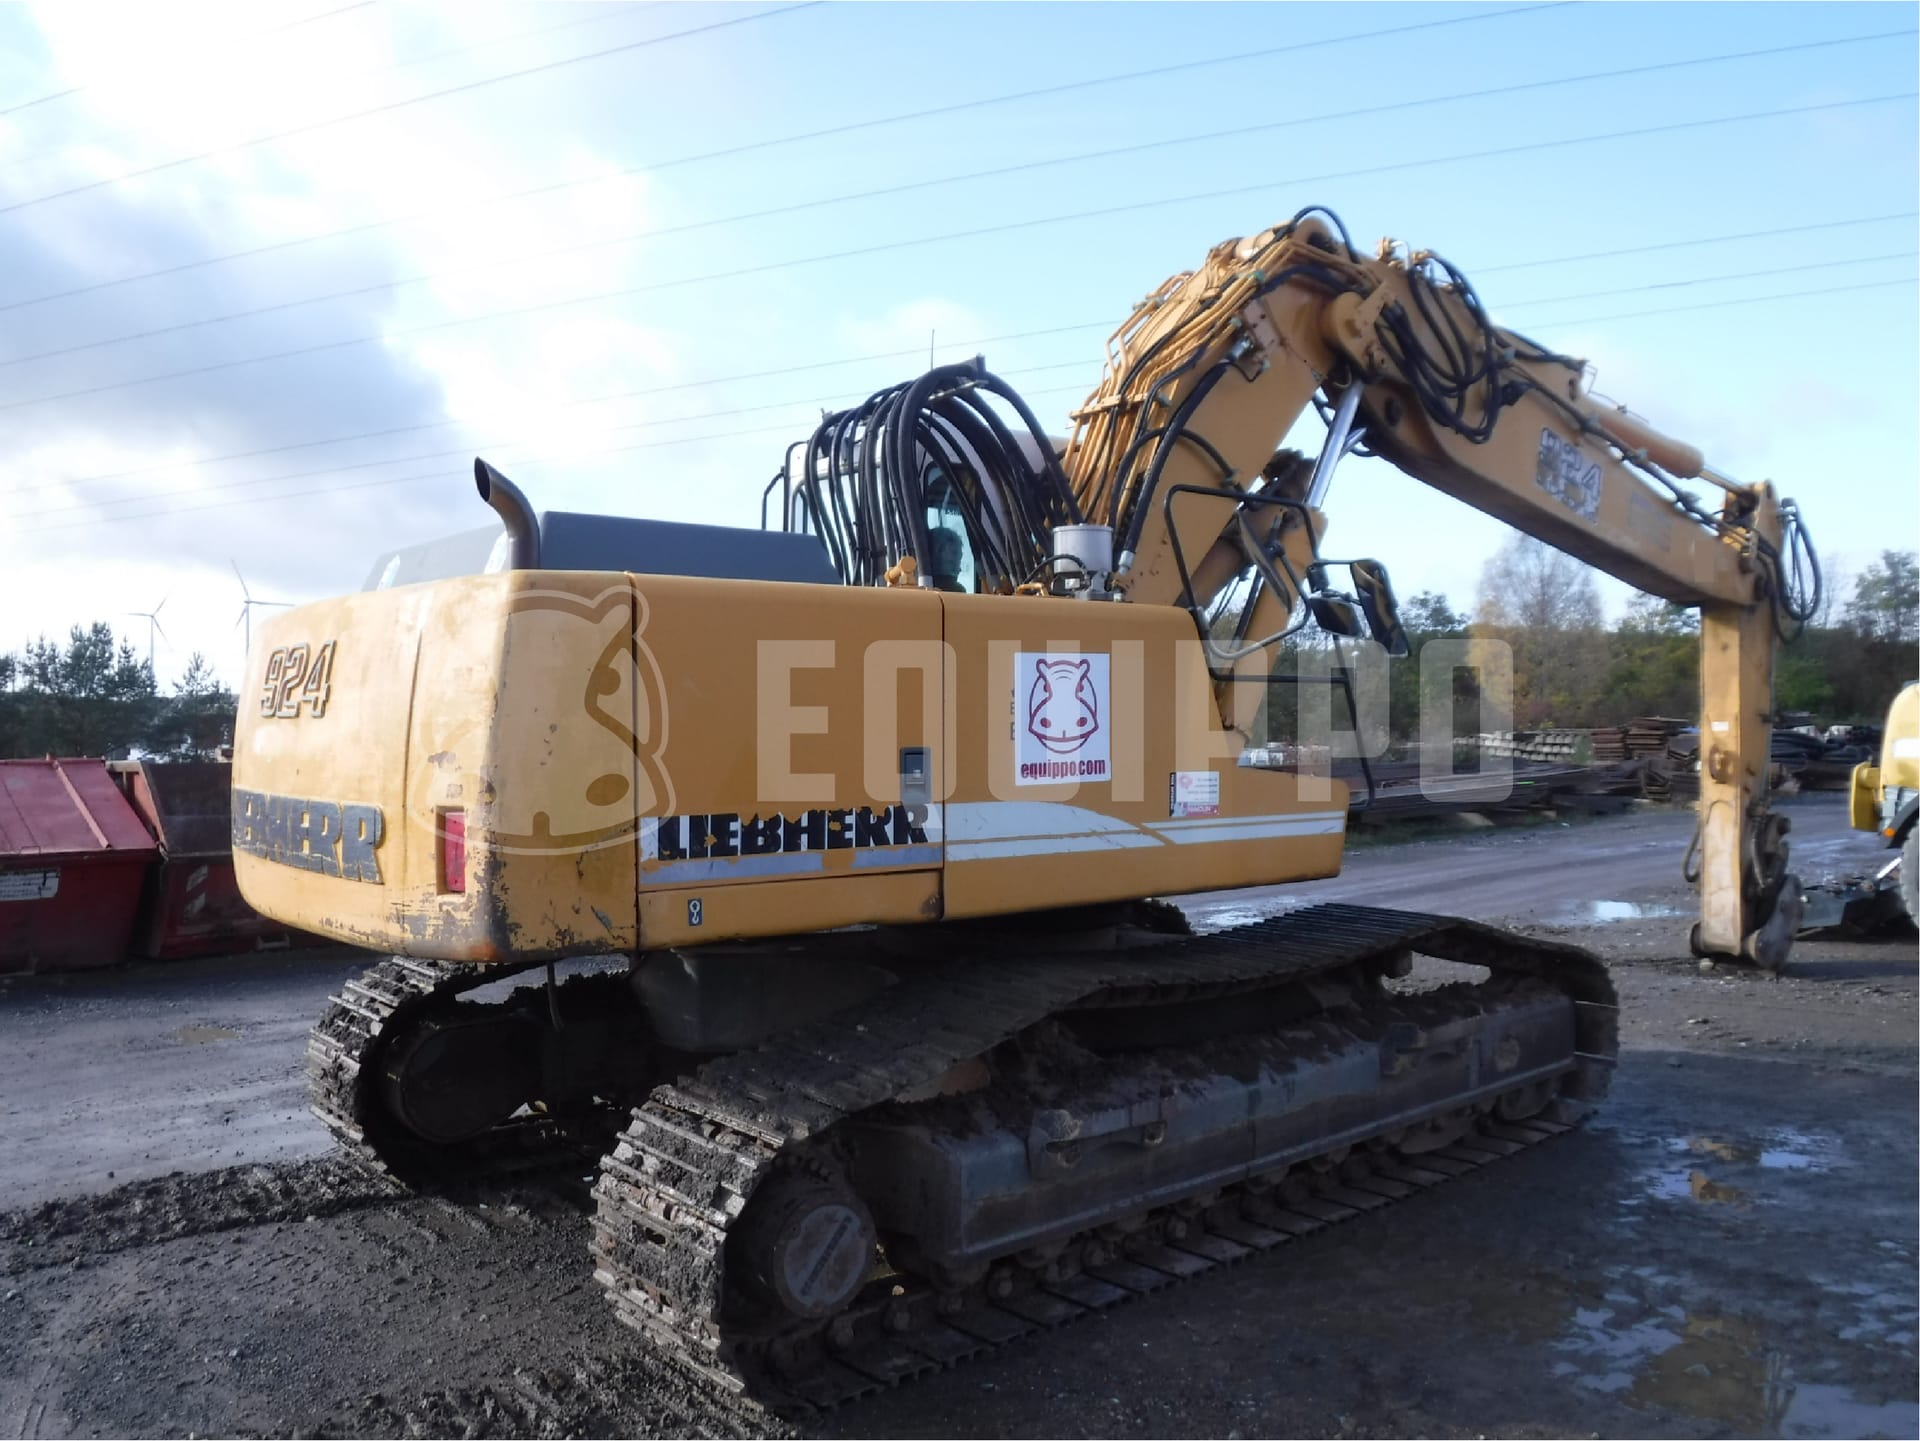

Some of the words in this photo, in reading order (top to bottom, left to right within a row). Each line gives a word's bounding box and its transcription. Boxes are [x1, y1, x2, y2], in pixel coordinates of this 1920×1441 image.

[260, 639, 336, 718] 924
[1020, 759, 1106, 780] equippo.com
[658, 805, 929, 860] LIEBHERR
